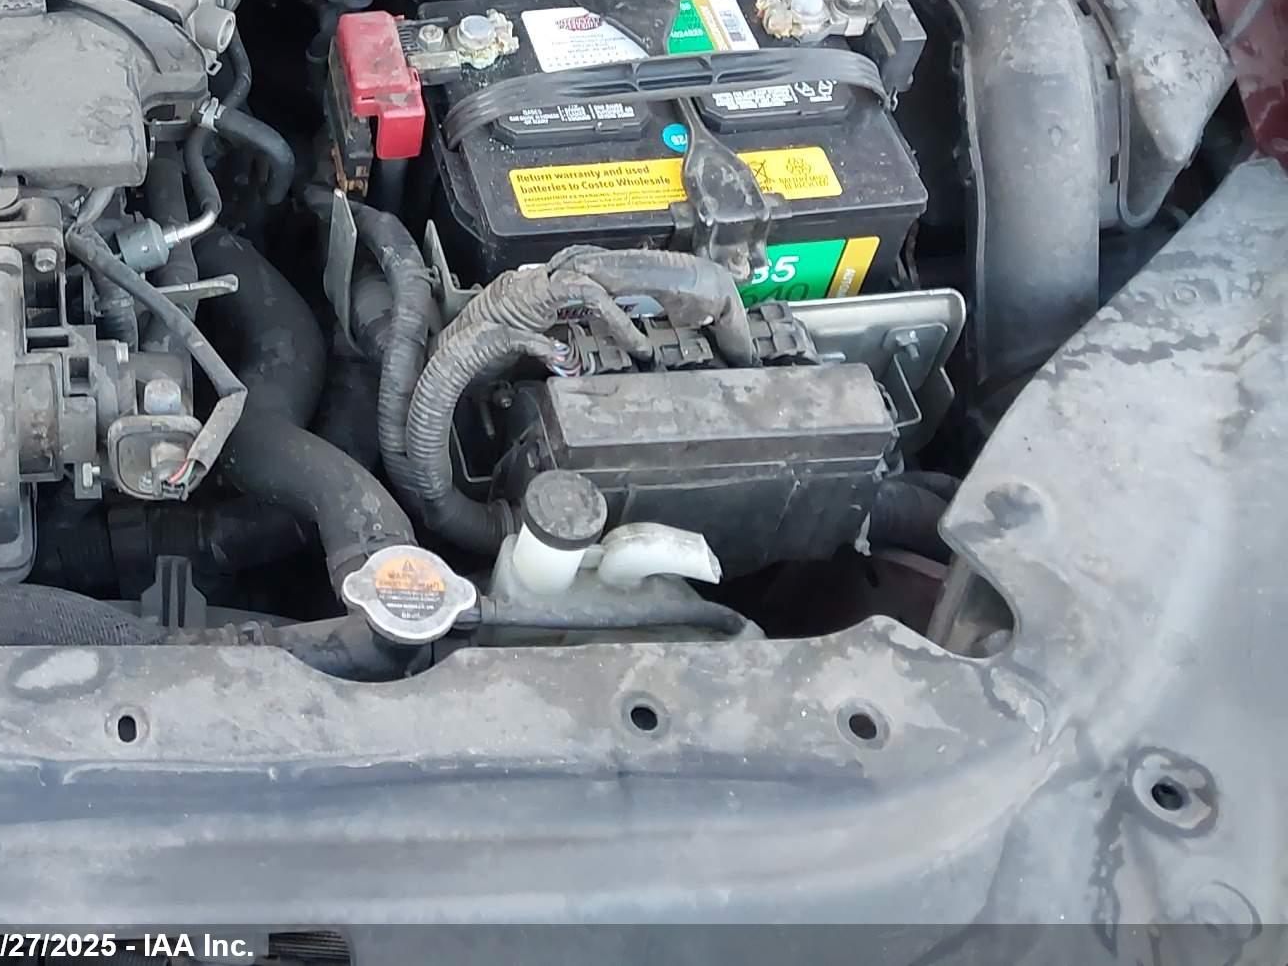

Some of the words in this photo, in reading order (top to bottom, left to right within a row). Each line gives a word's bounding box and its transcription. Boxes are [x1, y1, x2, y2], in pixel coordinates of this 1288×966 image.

[516, 173, 553, 183] Return
[554, 169, 601, 182] warranty
[603, 167, 623, 178] and
[625, 165, 650, 176] used
[520, 184, 567, 195] batteries
[569, 182, 580, 191] to
[581, 180, 615, 190] Costco
[616, 176, 671, 187] Wholesale
